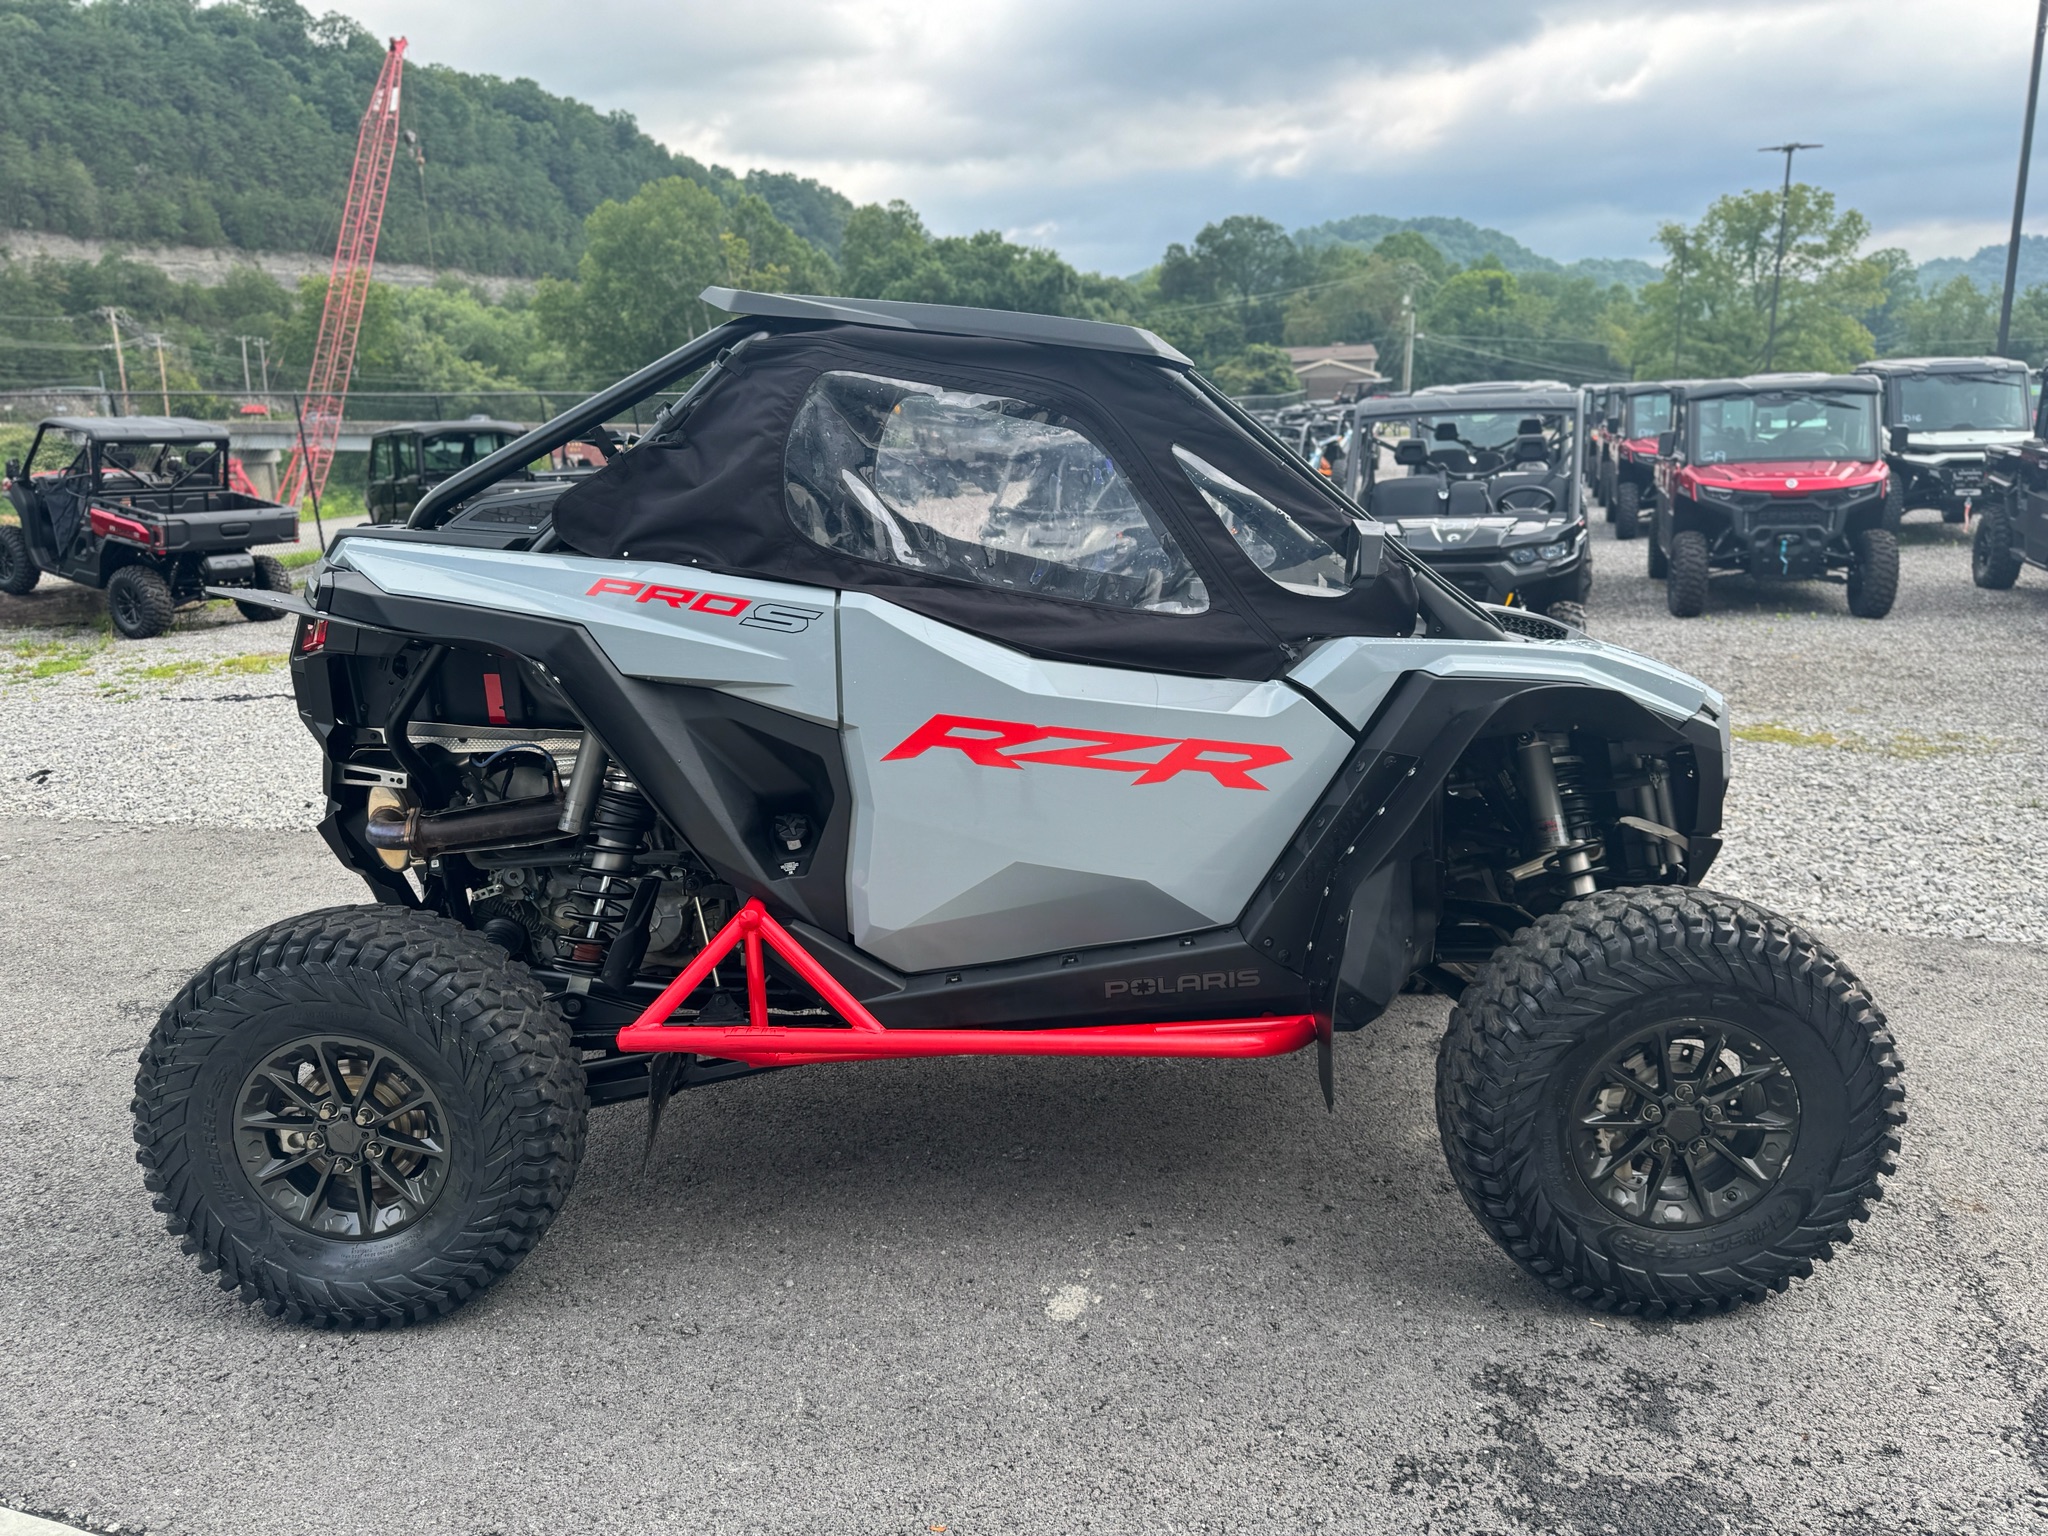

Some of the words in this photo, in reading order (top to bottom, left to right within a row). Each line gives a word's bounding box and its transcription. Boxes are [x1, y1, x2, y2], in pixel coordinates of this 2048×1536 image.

[585, 577, 753, 618] PRO
[738, 603, 824, 634] S
[879, 713, 1294, 791] RZR
[1104, 969, 1262, 999] POLARIS
